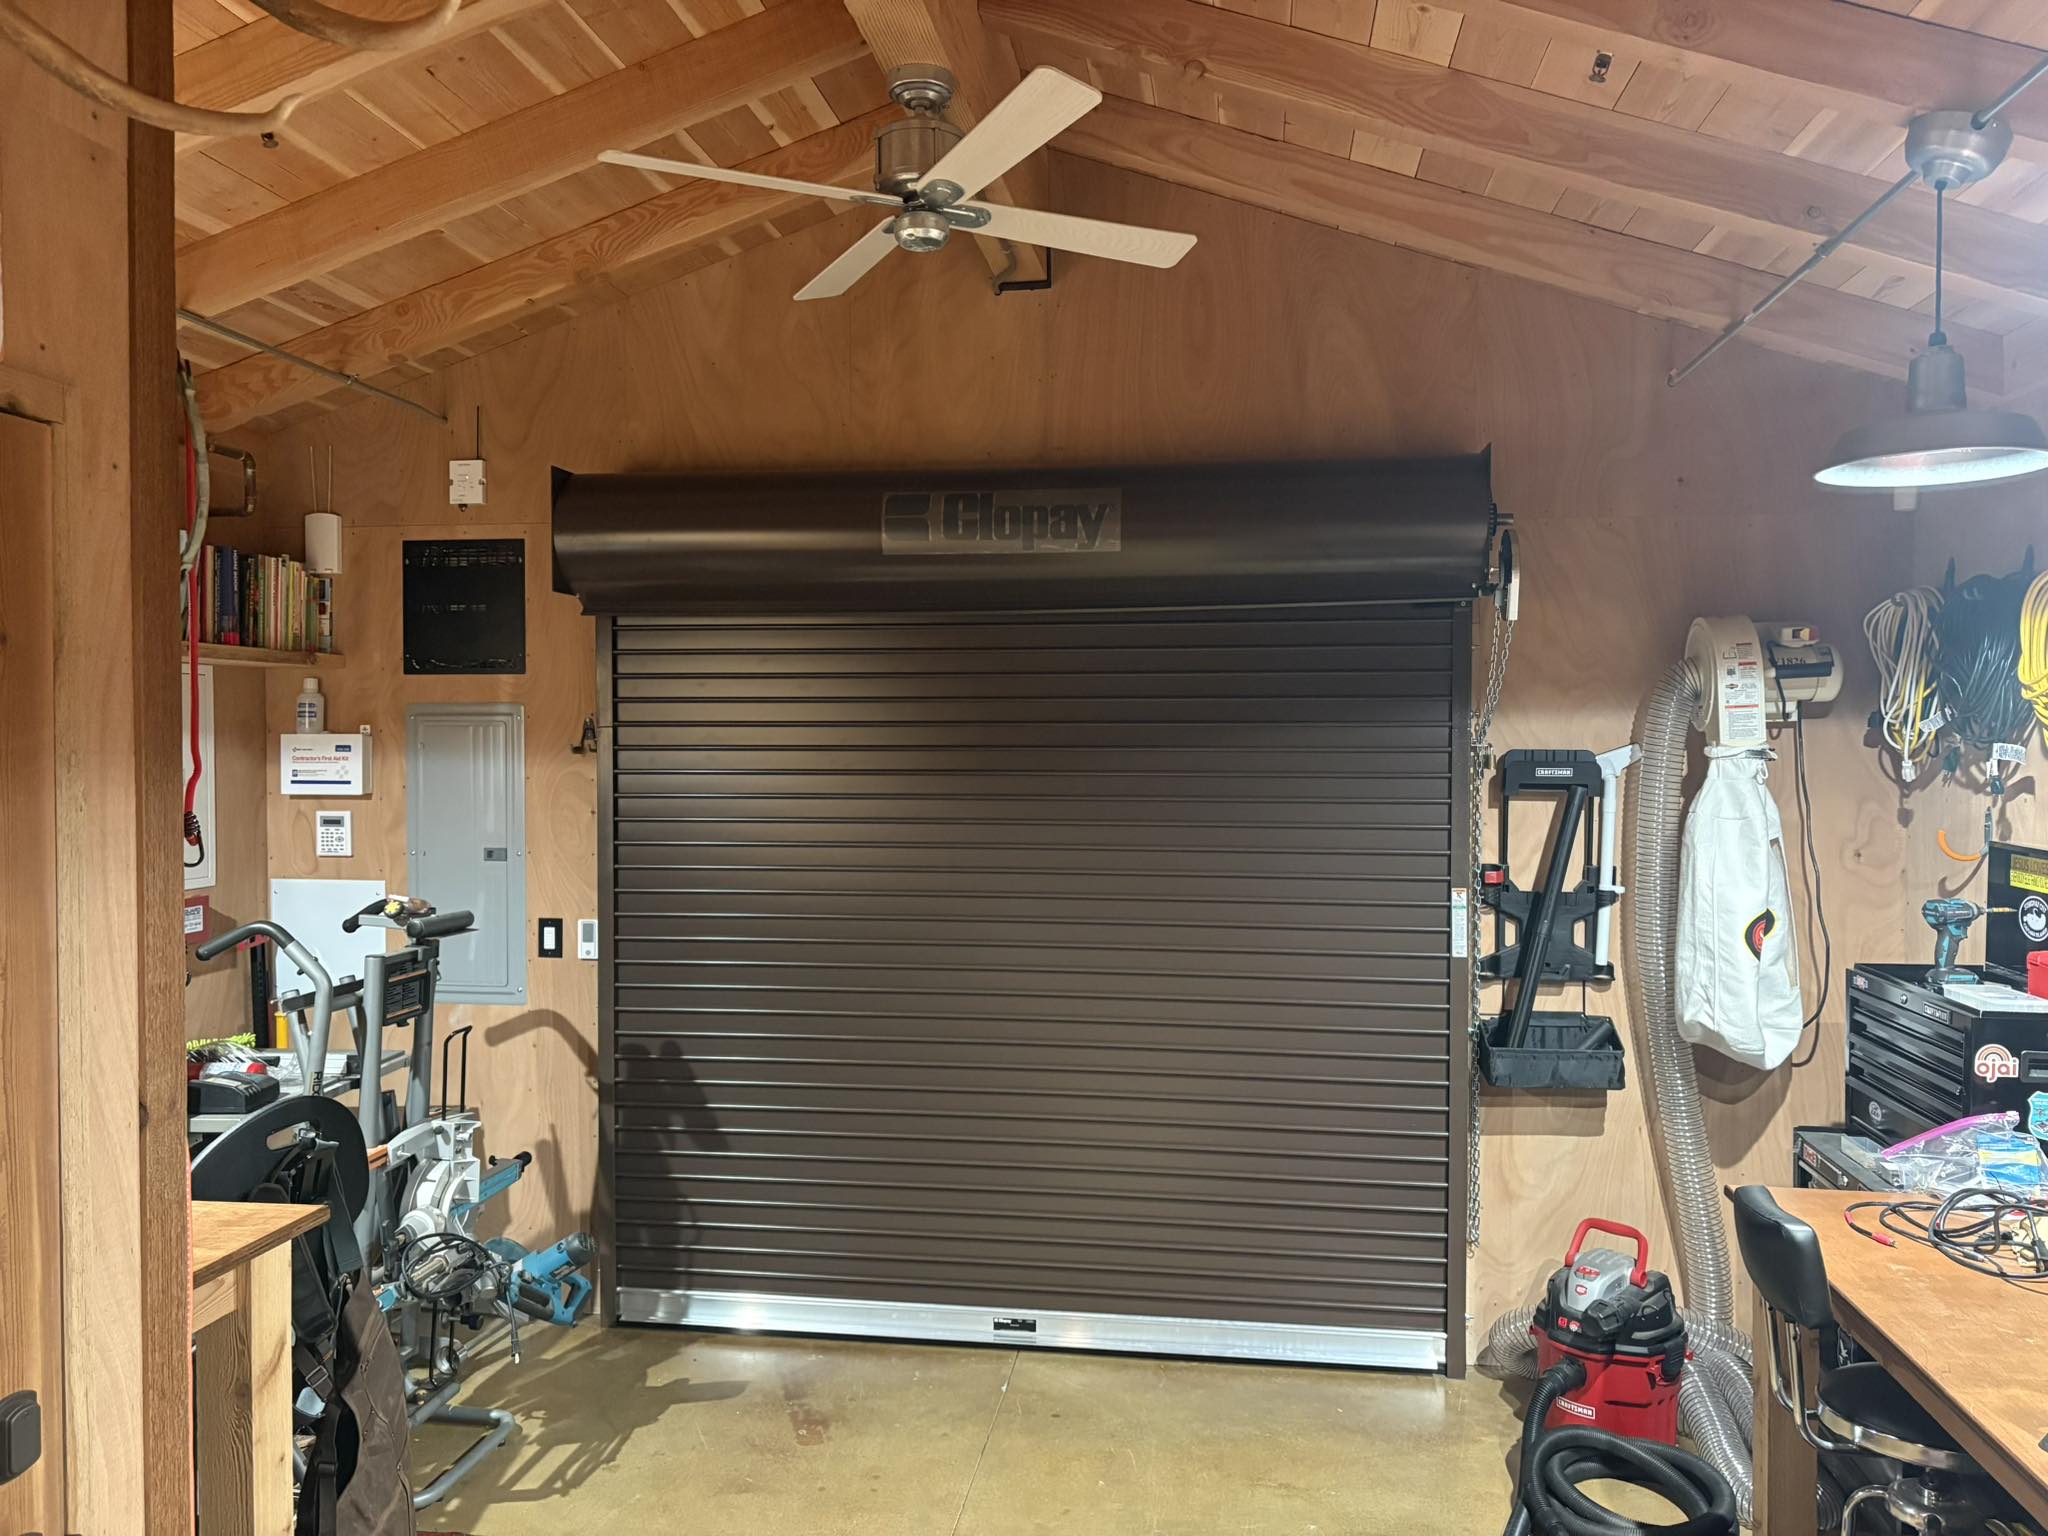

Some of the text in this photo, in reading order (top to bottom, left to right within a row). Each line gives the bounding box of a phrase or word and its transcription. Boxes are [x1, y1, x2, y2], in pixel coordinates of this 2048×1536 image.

[942, 493, 1110, 551] Clopay
[1976, 1057, 2018, 1080] ojai
[1558, 1399, 1593, 1416] CRAFTSMAN
